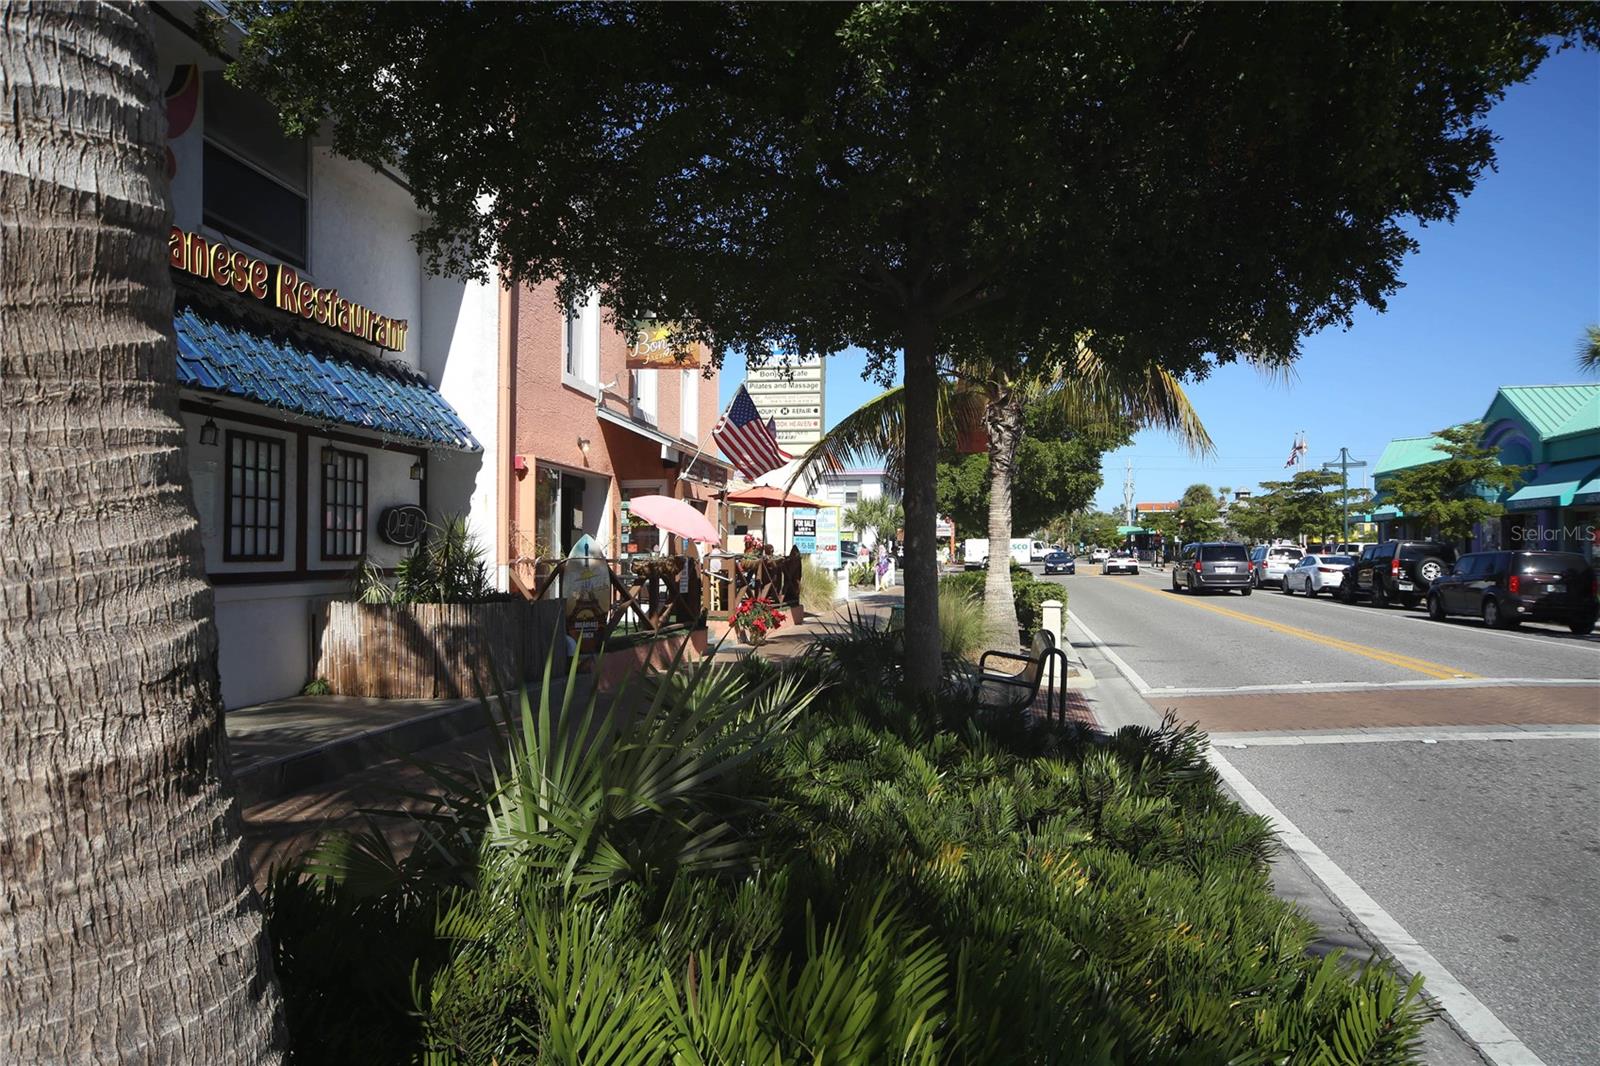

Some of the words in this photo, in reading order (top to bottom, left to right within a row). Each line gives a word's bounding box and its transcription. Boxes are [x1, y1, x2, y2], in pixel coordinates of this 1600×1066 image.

[168, 225, 268, 299] anese
[276, 263, 408, 353] Restaurant
[789, 382, 819, 390] Massage
[804, 519, 815, 527] SALE
